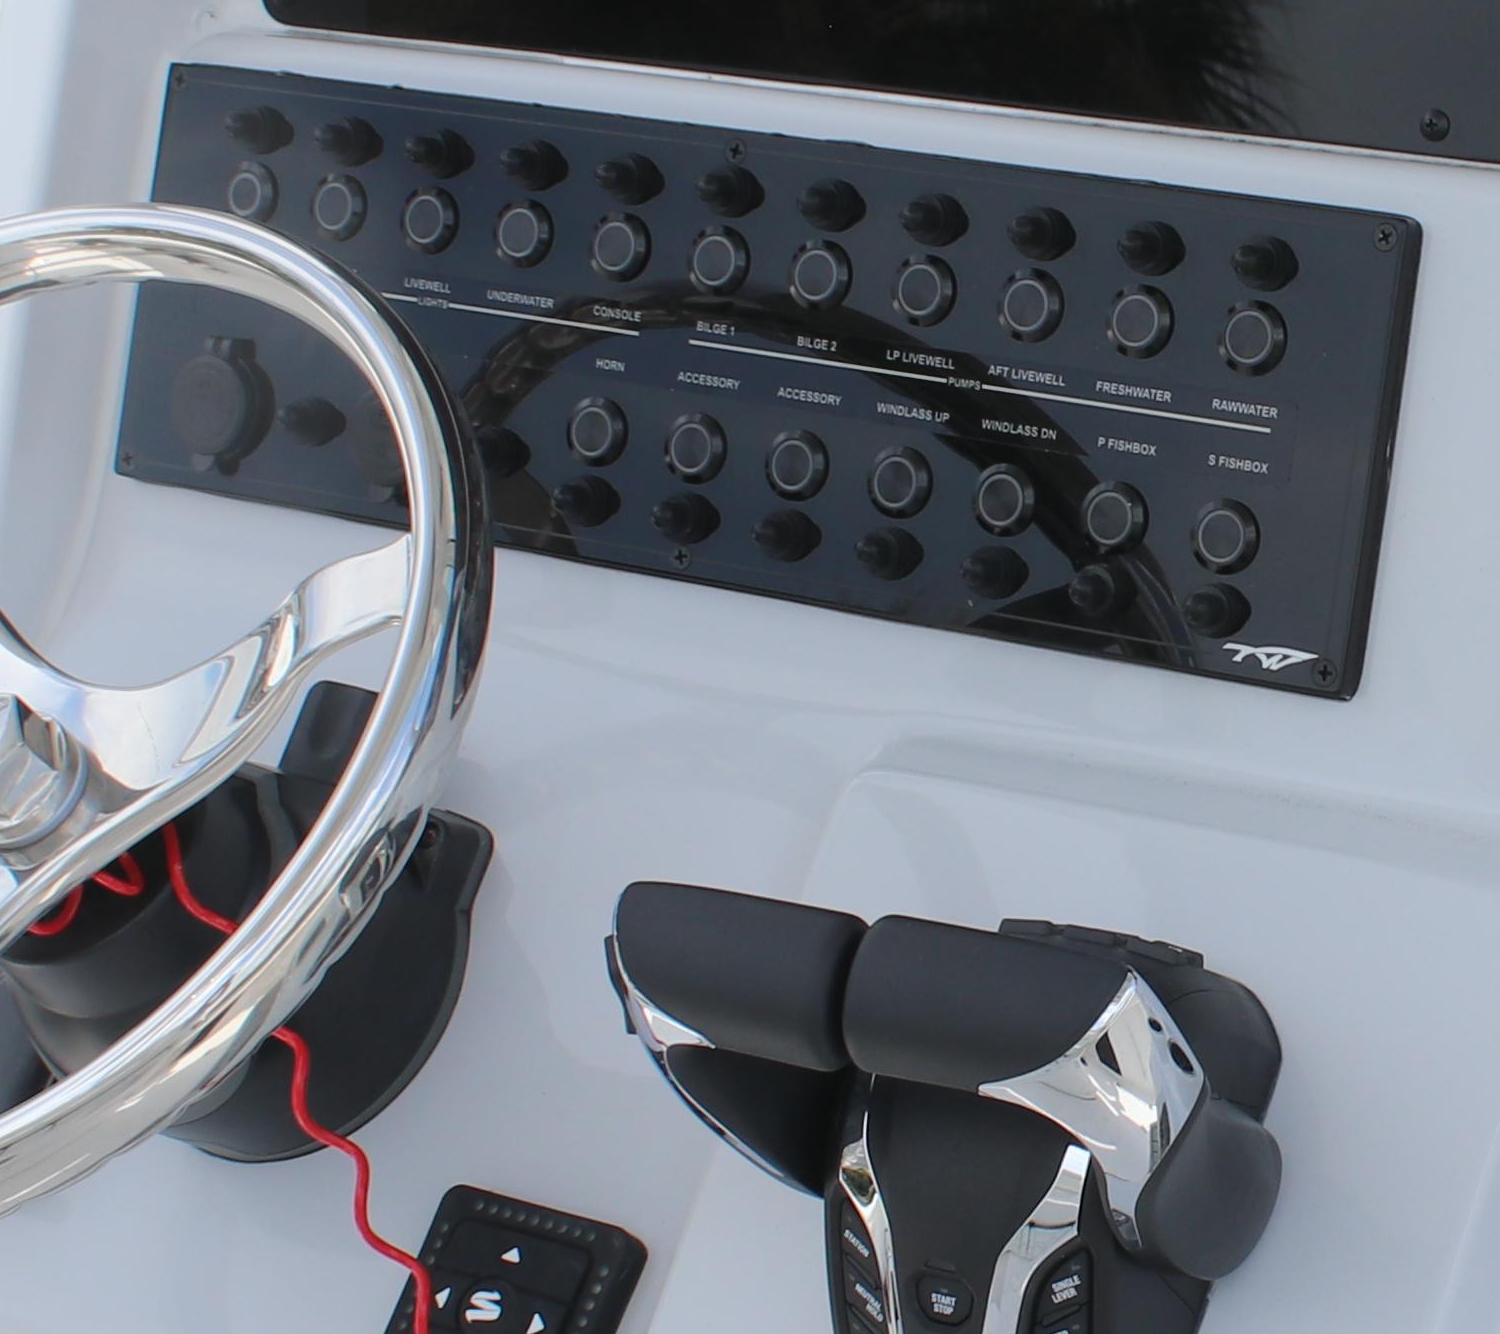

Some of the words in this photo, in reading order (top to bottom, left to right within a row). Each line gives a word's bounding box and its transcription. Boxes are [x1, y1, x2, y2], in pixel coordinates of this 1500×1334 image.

[404, 277, 451, 295] LIVEWELL
[417, 295, 448, 310] LIGHTS
[487, 289, 554, 311] UNDERWATER
[593, 304, 641, 323] CONSOLE
[696, 320, 726, 336] BILGE
[729, 324, 735, 337] 1
[796, 335, 828, 352] BILGE
[830, 340, 837, 353] 2
[596, 357, 625, 373] HORN
[886, 349, 900, 364] LP
[902, 351, 955, 371] LIVEWELL
[677, 370, 740, 391] ACCESSORY
[947, 375, 981, 392] PUMPS
[988, 364, 1009, 380] AFT
[1011, 367, 1066, 387] LIVEWELL
[777, 386, 842, 406] ACCESSORY
[1095, 380, 1172, 404] FRESHWATER
[876, 402, 932, 422] WINDLASS
[934, 410, 950, 424] UP
[1211, 397, 1278, 420] RAWWATER
[981, 419, 1038, 440] WINDLASS
[1040, 425, 1057, 441] DN
[1098, 436, 1106, 450] P
[1108, 438, 1157, 457] FISHBOX
[1207, 453, 1216, 469] S
[1218, 455, 1269, 476] FISHBOX
[844, 1229, 870, 1258] STATION
[1052, 1274, 1081, 1292] SINGLE
[855, 1282, 882, 1311] NEUTRAL
[931, 1292, 956, 1306] START
[1052, 1286, 1077, 1304] LEVER
[866, 1301, 883, 1323] HOLD
[933, 1303, 955, 1316] STOP
